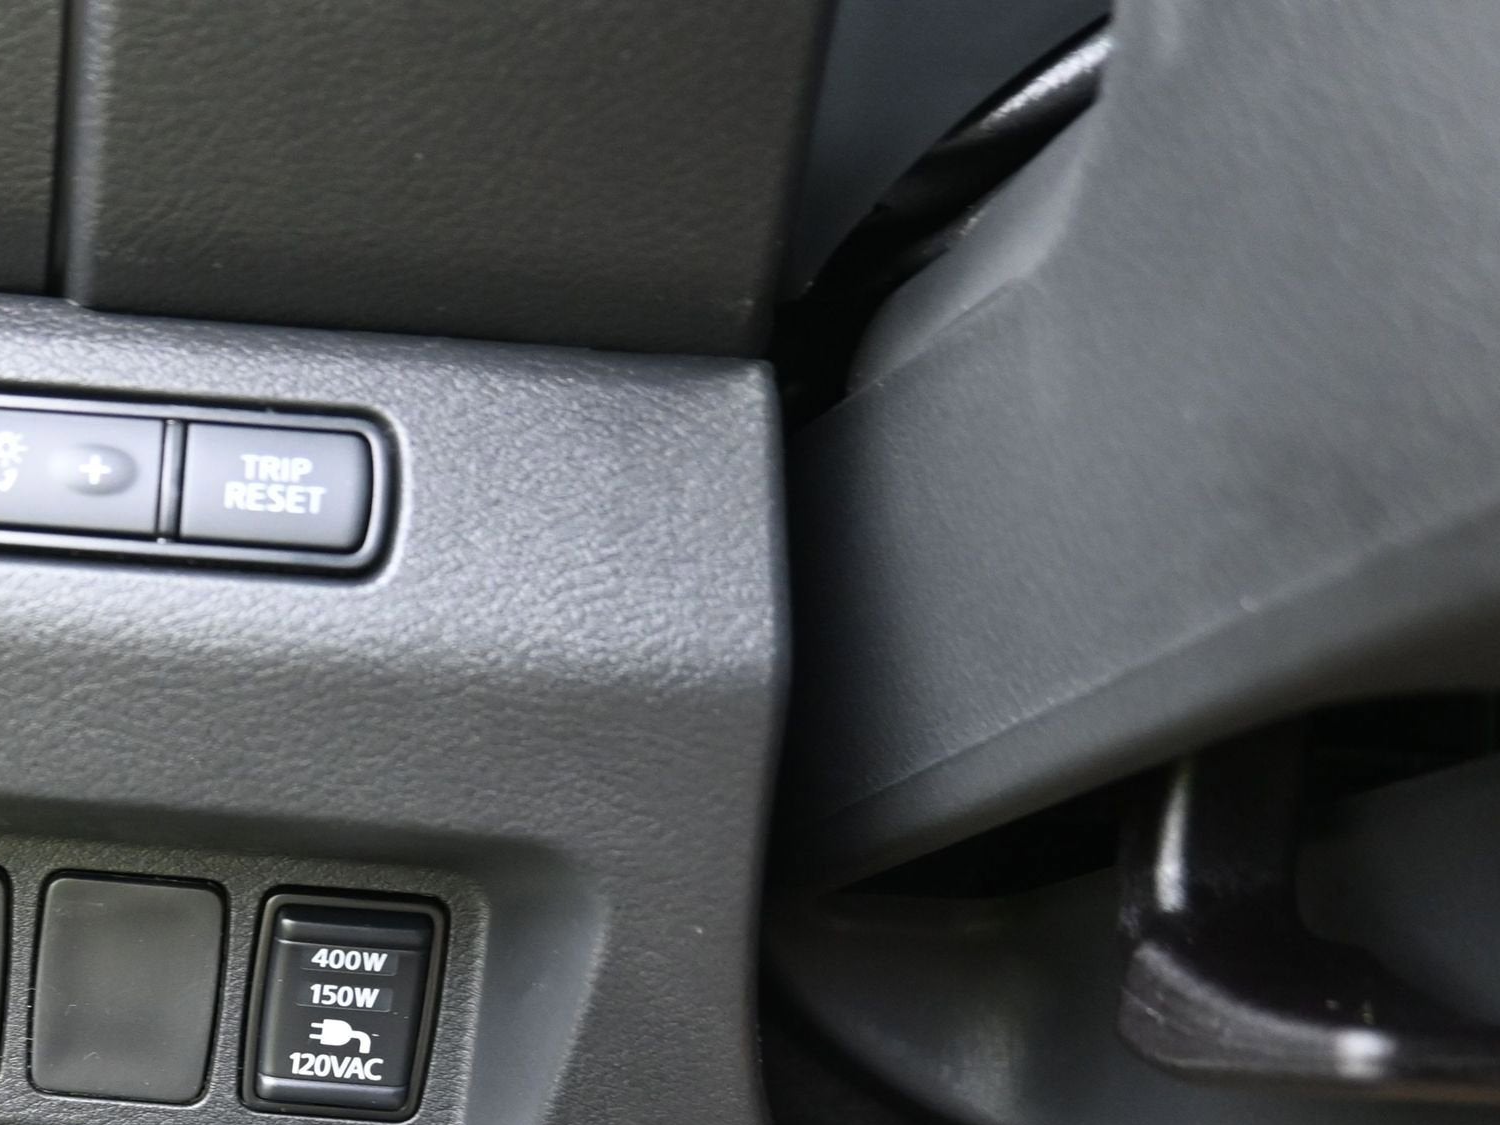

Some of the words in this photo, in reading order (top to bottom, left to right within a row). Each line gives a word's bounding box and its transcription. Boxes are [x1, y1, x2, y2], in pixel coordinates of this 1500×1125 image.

[240, 454, 313, 482] TRIP
[224, 481, 327, 514] RESET
[311, 948, 388, 972] 400W
[310, 983, 379, 1008] 150W
[289, 1052, 384, 1081] 120VAC
